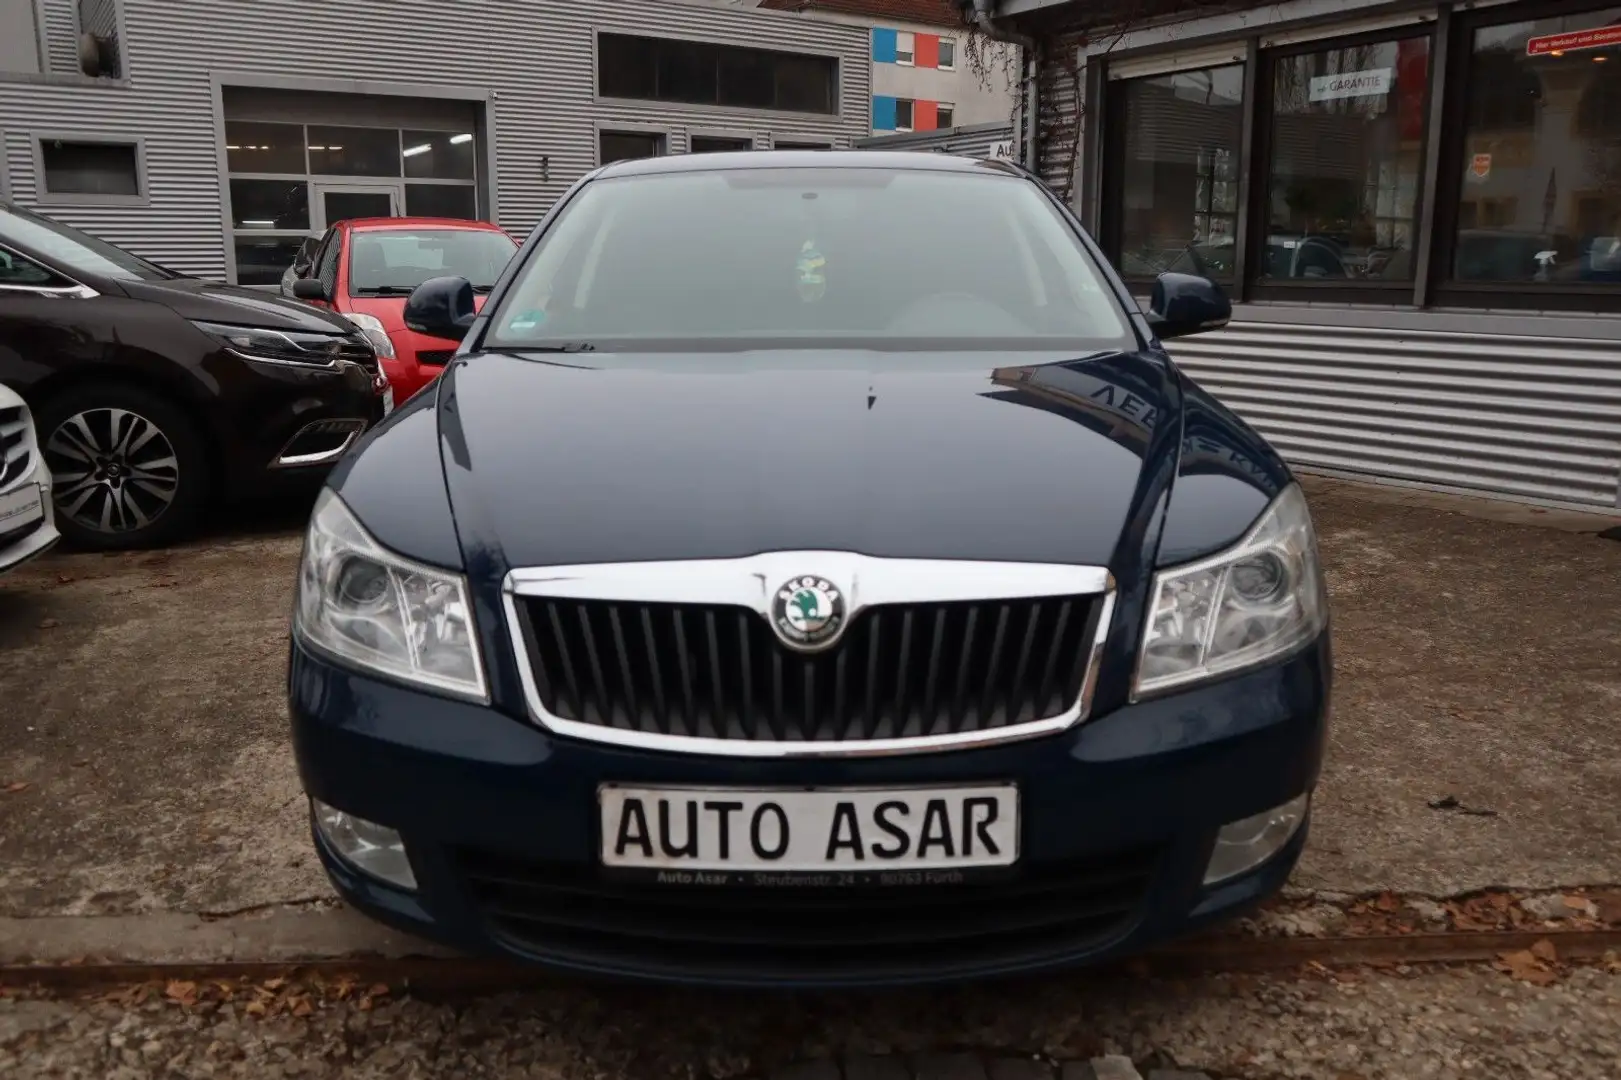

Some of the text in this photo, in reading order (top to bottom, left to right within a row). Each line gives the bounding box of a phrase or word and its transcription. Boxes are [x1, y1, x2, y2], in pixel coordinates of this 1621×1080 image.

[1329, 76, 1381, 92] GARANTIE
[614, 796, 1001, 861] AUTO ASAR
[656, 871, 692, 884] Auto
[694, 871, 728, 885] Asar
[837, 873, 855, 886] 24
